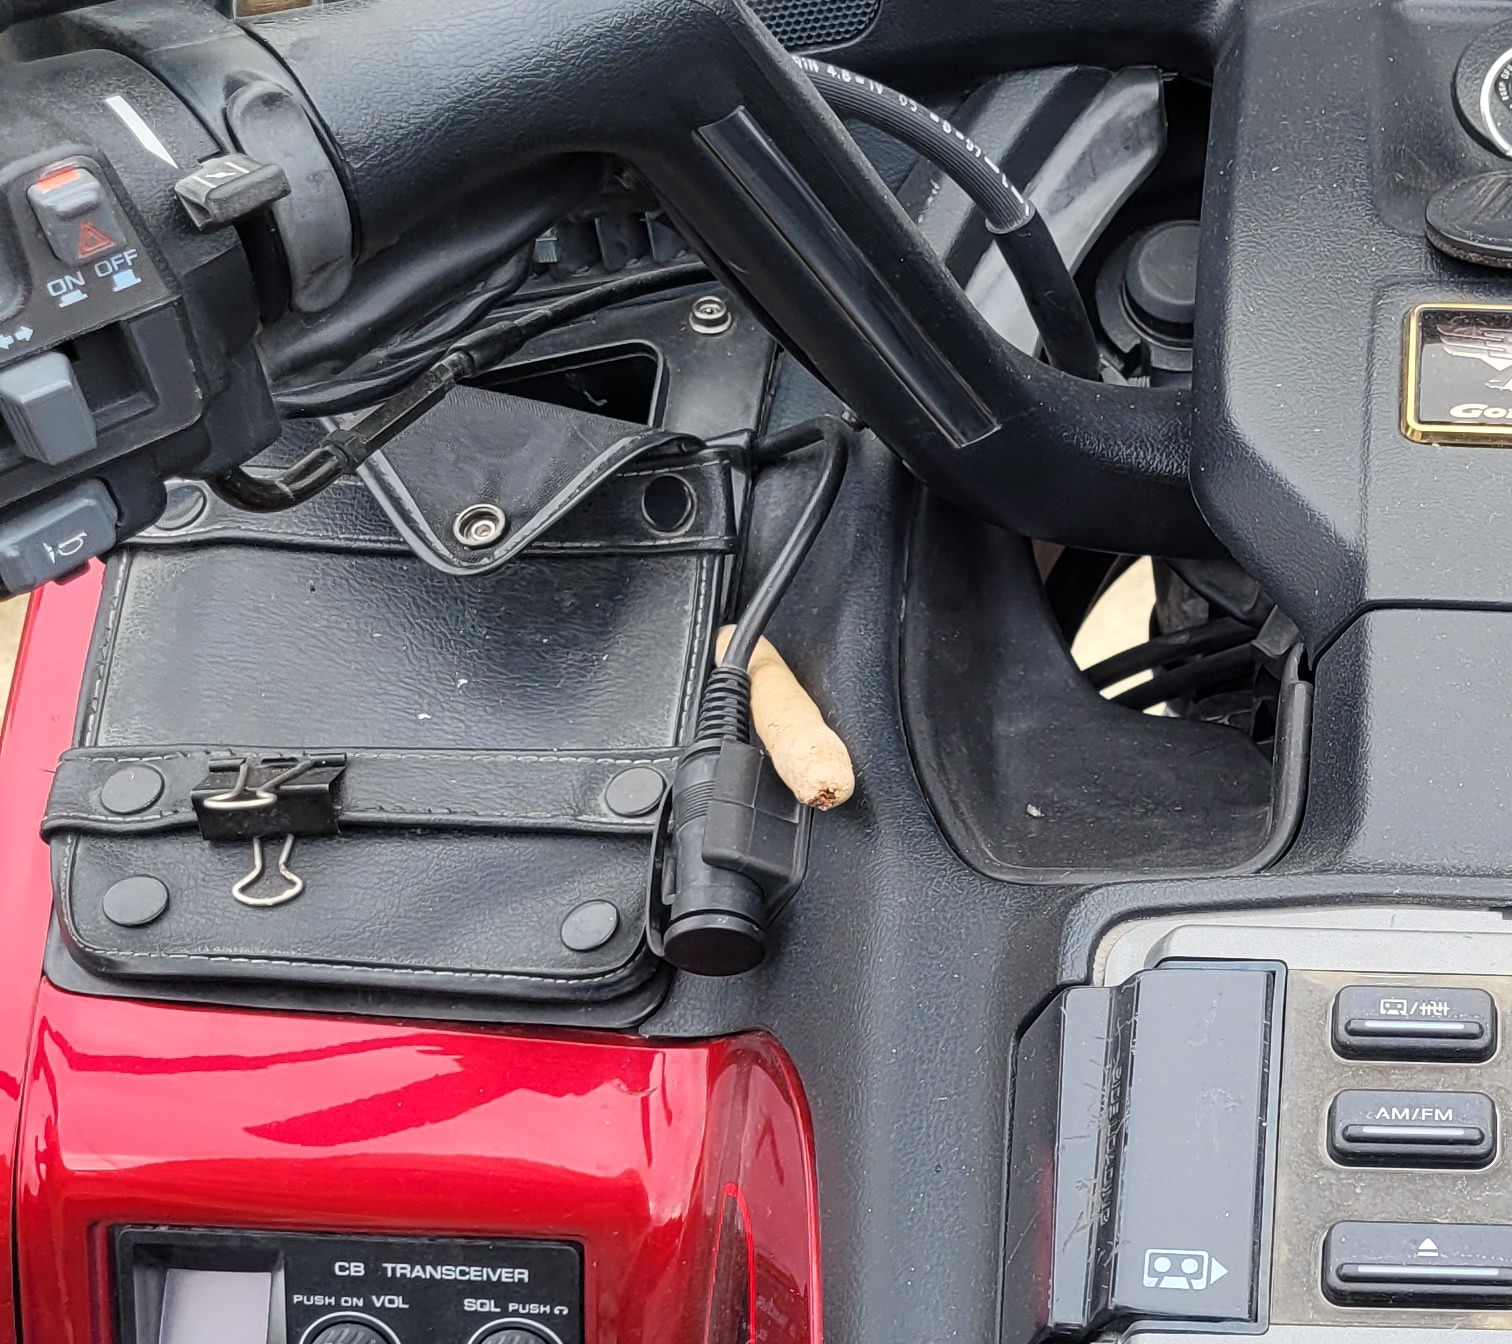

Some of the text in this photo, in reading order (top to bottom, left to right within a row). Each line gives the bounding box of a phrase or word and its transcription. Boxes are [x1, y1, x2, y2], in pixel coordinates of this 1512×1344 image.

[94, 248, 139, 279] OFF
[46, 270, 86, 298] ON
[1374, 1106, 1454, 1122] AM/FM
[333, 1260, 530, 1284] CB TRANSCEIVER
[293, 1294, 410, 1309] PUSH ON VOL
[463, 1297, 551, 1315] SQL PUSH
